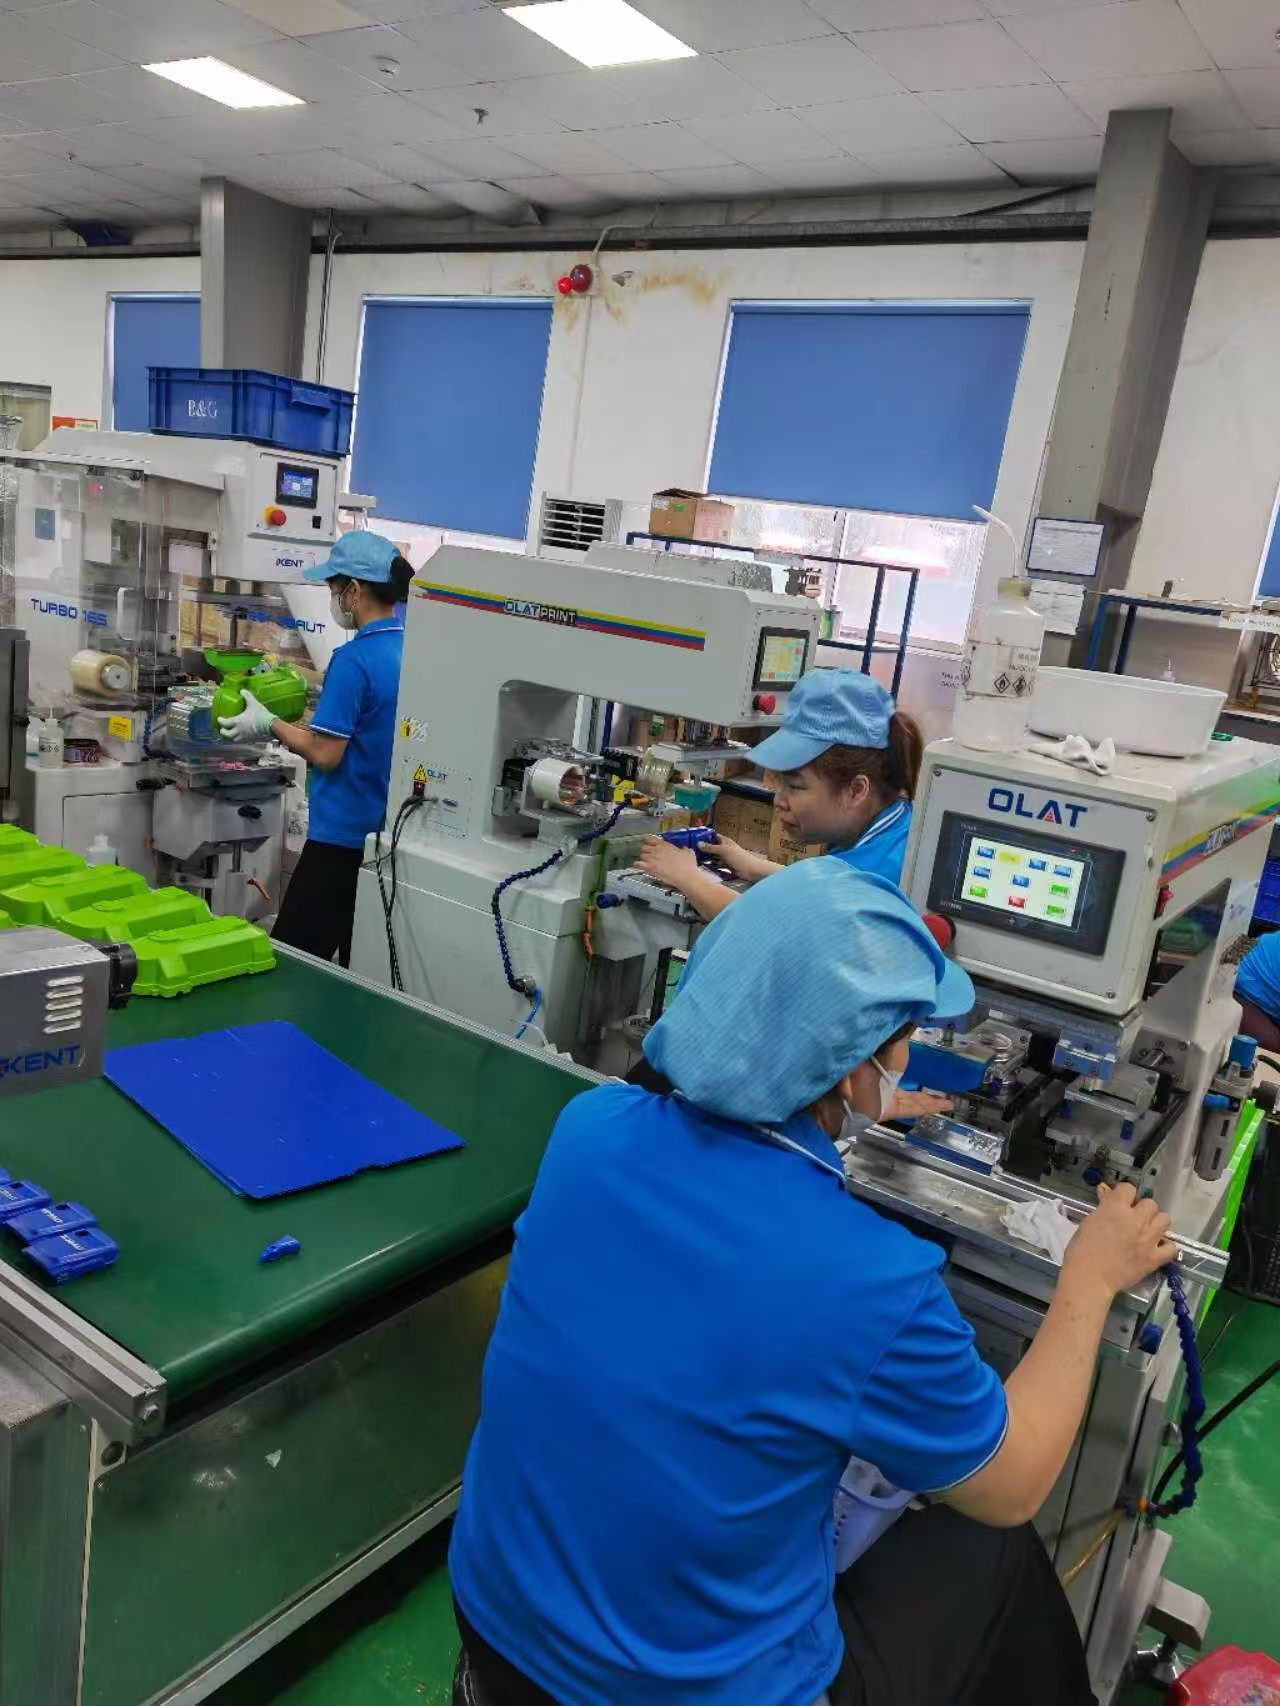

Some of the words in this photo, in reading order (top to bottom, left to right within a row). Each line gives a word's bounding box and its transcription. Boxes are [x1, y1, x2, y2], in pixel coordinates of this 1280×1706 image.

[188, 399, 217, 418] B&G
[31, 598, 77, 619] TURBO
[505, 600, 576, 624] OLATPRINT
[988, 788, 1088, 828] OLAT
